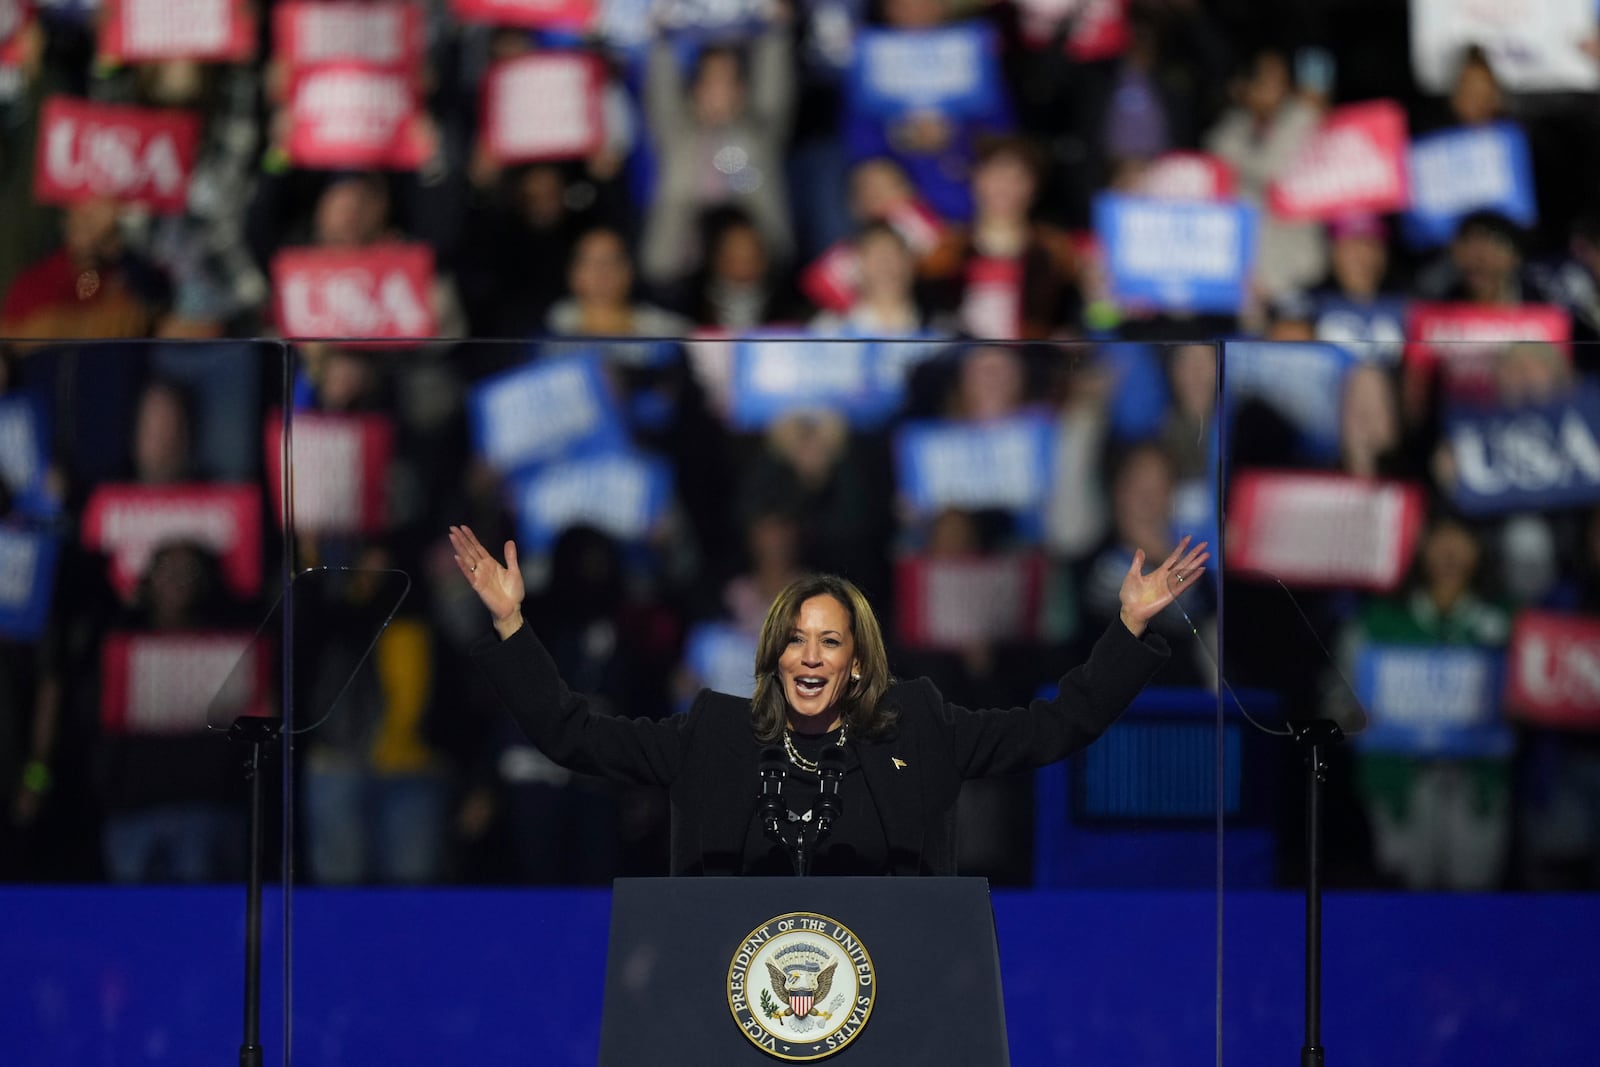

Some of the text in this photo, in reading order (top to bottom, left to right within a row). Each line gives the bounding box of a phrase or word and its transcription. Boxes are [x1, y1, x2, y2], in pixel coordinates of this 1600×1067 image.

[46, 117, 184, 196] USA
[283, 271, 428, 337] USA
[1455, 407, 1600, 496] USA
[1519, 632, 1600, 710] US
[731, 918, 872, 1051] VICE PRESIDENT OF THE UNITED STATES
